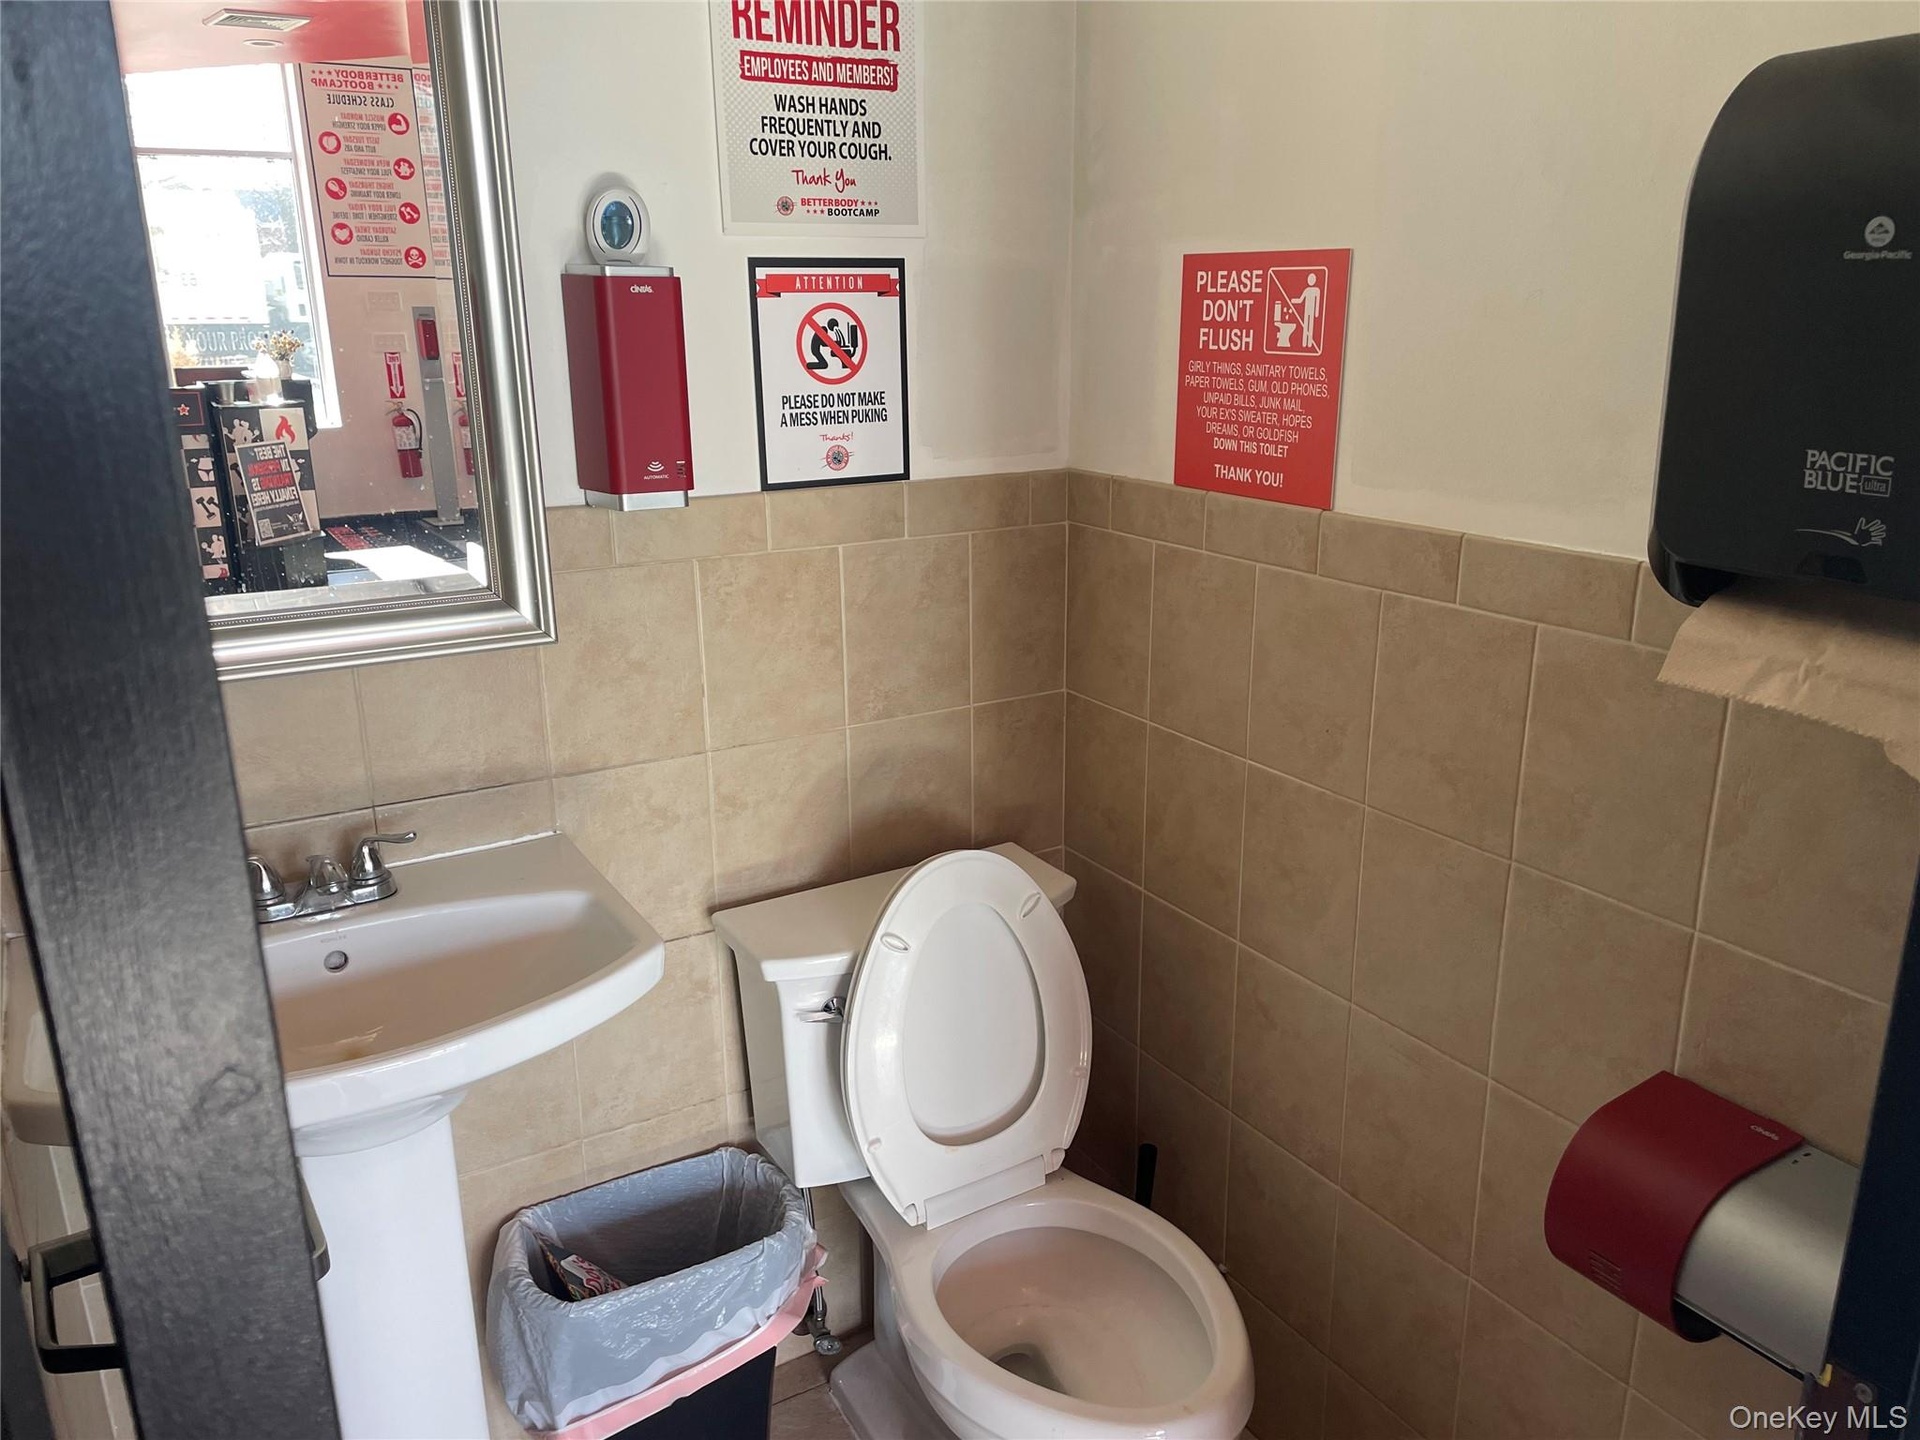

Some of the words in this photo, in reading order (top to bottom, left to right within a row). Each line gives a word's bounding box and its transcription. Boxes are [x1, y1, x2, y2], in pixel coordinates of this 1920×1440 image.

[731, 0, 900, 52] REMINDER
[744, 56, 809, 81] EMPLOYEES
[812, 61, 834, 83] AND
[836, 64, 894, 86] MEMBERS!
[774, 94, 815, 114] WASH
[819, 97, 867, 116] HANDS
[761, 116, 848, 138] FREQUENTLY
[852, 121, 882, 139] AND
[749, 138, 795, 157] COVER
[798, 140, 836, 159] YOUR
[839, 143, 892, 161] COUGH.
[792, 168, 831, 187] Thank
[835, 168, 856, 193] You
[800, 197, 859, 208] BETTERBODY
[827, 208, 880, 217] BOOTCAMP
[795, 275, 864, 290] ATTENTION
[1196, 270, 1263, 293] PLEASE
[1202, 300, 1254, 322] DON'T
[1199, 328, 1254, 351] FLUSH
[1188, 360, 1211, 374] GIRLY
[1212, 362, 1243, 376] THINGS,
[1245, 364, 1286, 378] SANITARY
[1289, 366, 1328, 382] TOWELS,
[1185, 375, 1210, 388] PAPER
[1212, 376, 1246, 392] TOWELS,
[1248, 380, 1269, 394] GUM,
[1271, 381, 1289, 394] OLD
[1291, 383, 1330, 399] PHONES,
[781, 394, 819, 410] PLEASE
[821, 393, 834, 408] DO
[837, 392, 857, 407] NOT
[858, 391, 886, 406] MAKE
[1203, 393, 1232, 405] UNPAID
[1234, 394, 1257, 408] BILLS,
[1259, 397, 1281, 410] JUNK
[1283, 398, 1305, 413] MAIL,
[780, 414, 788, 427] A
[789, 412, 818, 427] MESS
[820, 410, 849, 425] WHEN
[852, 408, 888, 424] PUKING
[1197, 406, 1218, 419] YOUR
[1219, 407, 1237, 420] EX'S
[1238, 408, 1280, 426] SWEATER,
[1282, 415, 1312, 429] HOPES
[819, 432, 854, 442] Thanks!
[1206, 422, 1240, 437] DREAMS,
[1242, 425, 1254, 438] OR
[1256, 427, 1299, 443] GOLDFISH
[1213, 438, 1237, 452] DOWN
[1239, 440, 1258, 454] THIS
[1259, 443, 1288, 458] TOILET
[1805, 450, 1895, 476] PACIFIC
[1214, 464, 1252, 483] THANK
[1254, 469, 1283, 488] YOU!
[1803, 470, 1858, 494] BLUE
[1864, 480, 1887, 493] ultra
